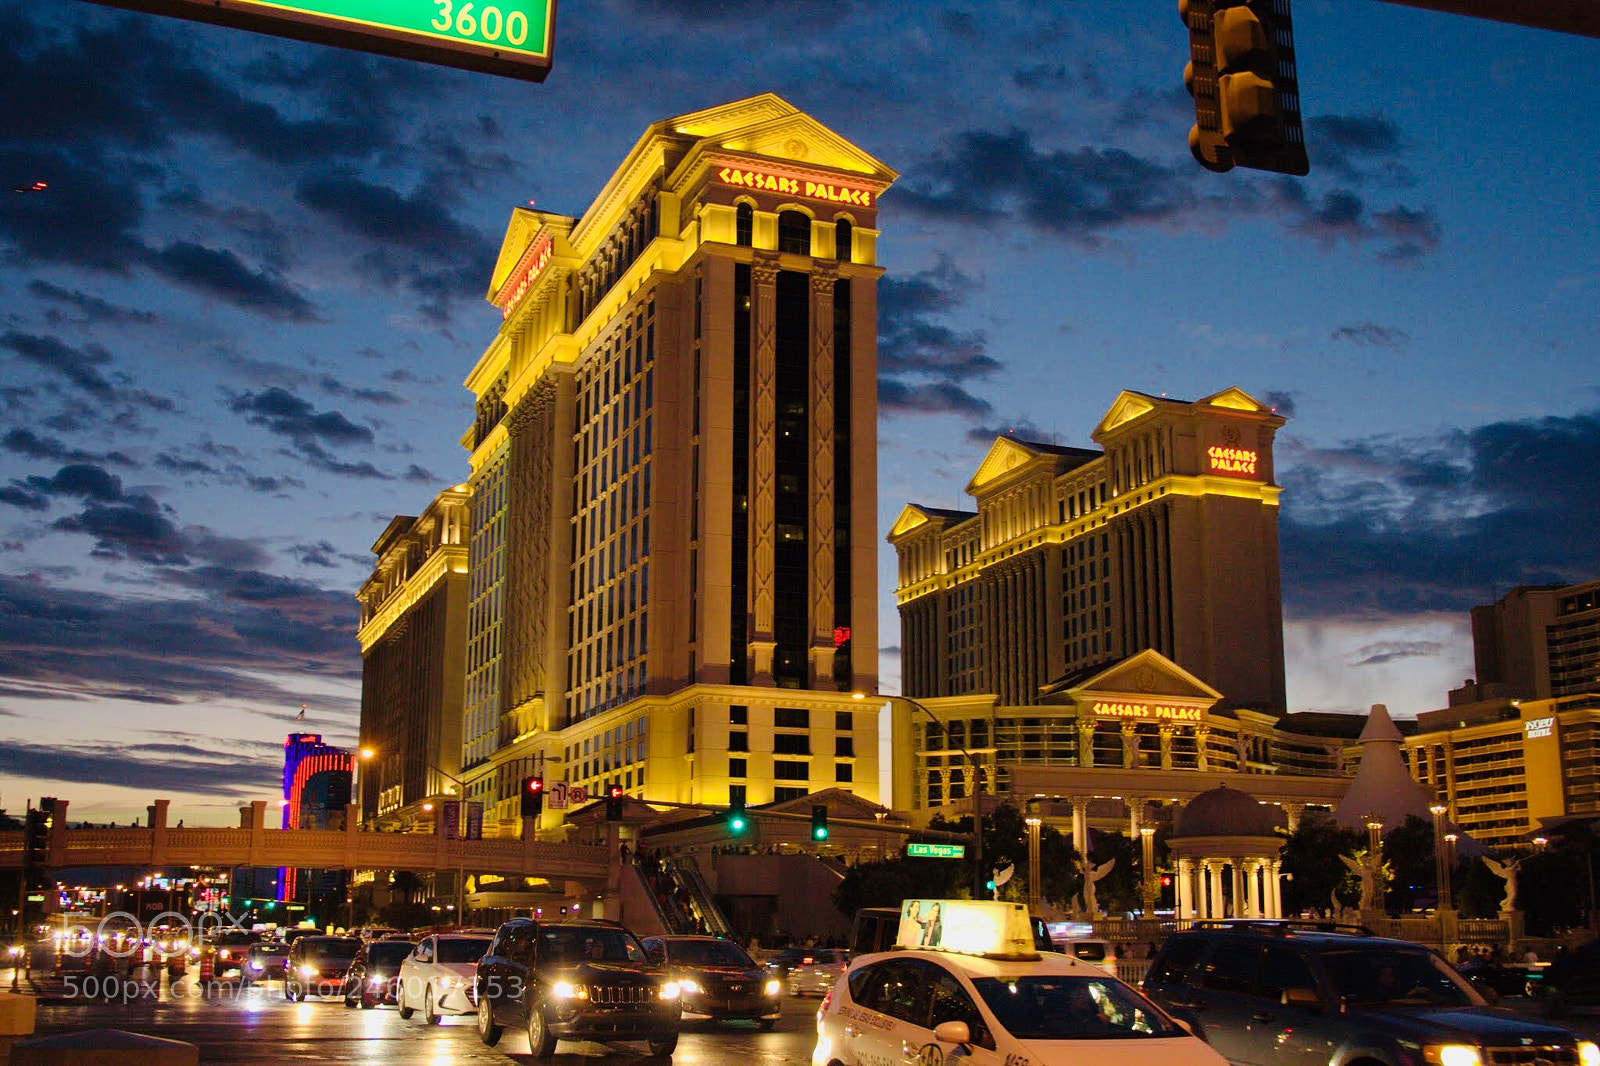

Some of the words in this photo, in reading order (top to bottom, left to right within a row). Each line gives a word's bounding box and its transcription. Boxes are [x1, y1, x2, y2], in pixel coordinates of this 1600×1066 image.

[431, 0, 528, 45] 3600
[719, 168, 799, 194] CAESARS
[805, 181, 870, 207] PALACE
[1208, 446, 1257, 462] CAESARS
[1211, 458, 1255, 474] PALACE
[1093, 702, 1149, 717] CAESARS
[1155, 706, 1201, 720] PALACE
[1525, 717, 1554, 730] NOBU
[913, 844, 928, 854] Las
[929, 845, 951, 857] Vegas
